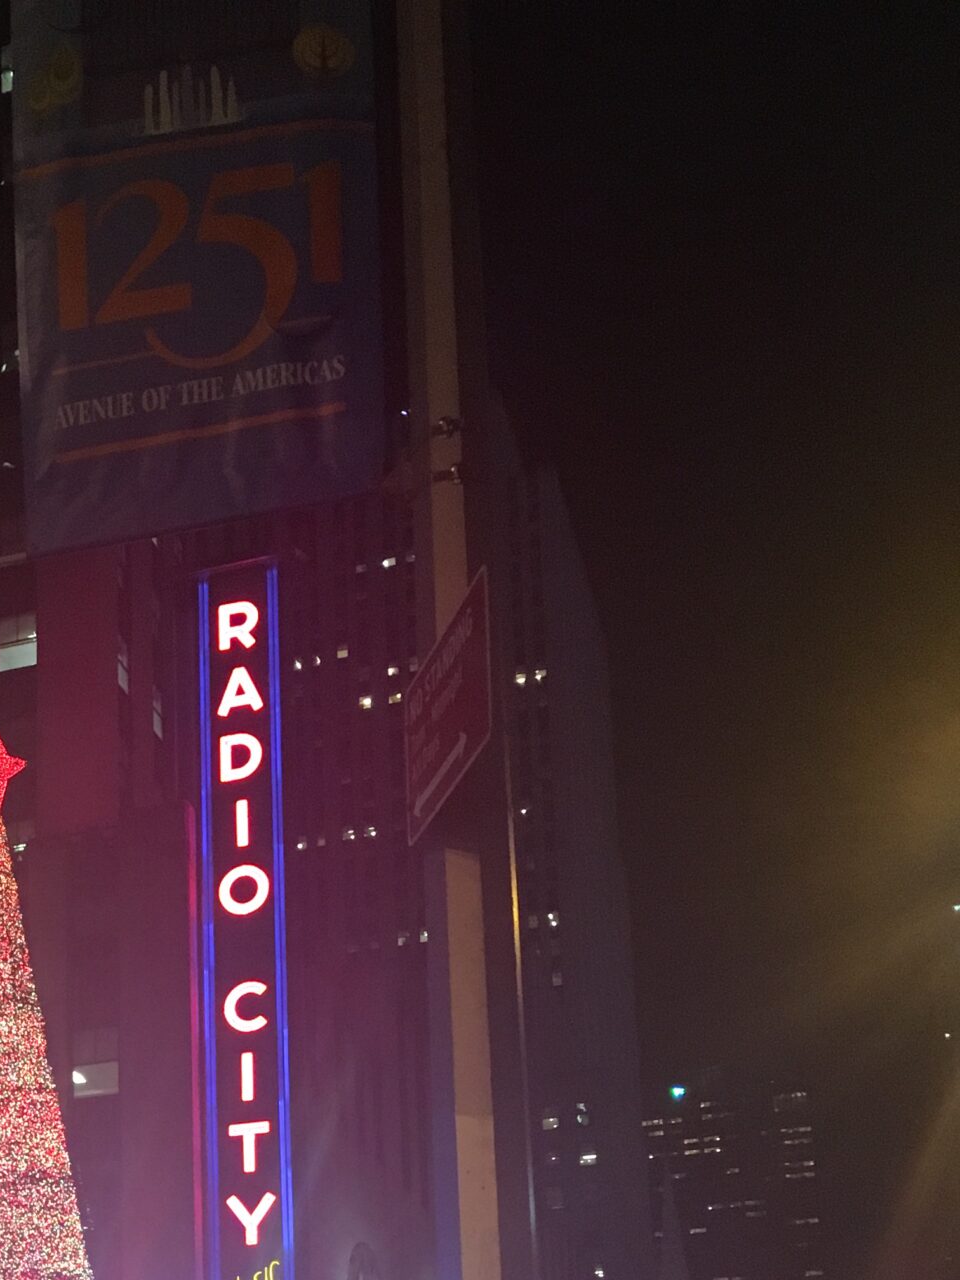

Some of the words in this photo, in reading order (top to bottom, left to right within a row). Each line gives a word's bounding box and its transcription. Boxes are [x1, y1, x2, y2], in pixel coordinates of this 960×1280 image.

[50, 159, 344, 370] 1251
[55, 393, 134, 430] AVENUE
[141, 385, 173, 414] OF
[178, 377, 224, 407] THE
[231, 354, 346, 398] AMERICAS
[217, 600, 270, 916] RADIO
[223, 980, 276, 1246] CITY
